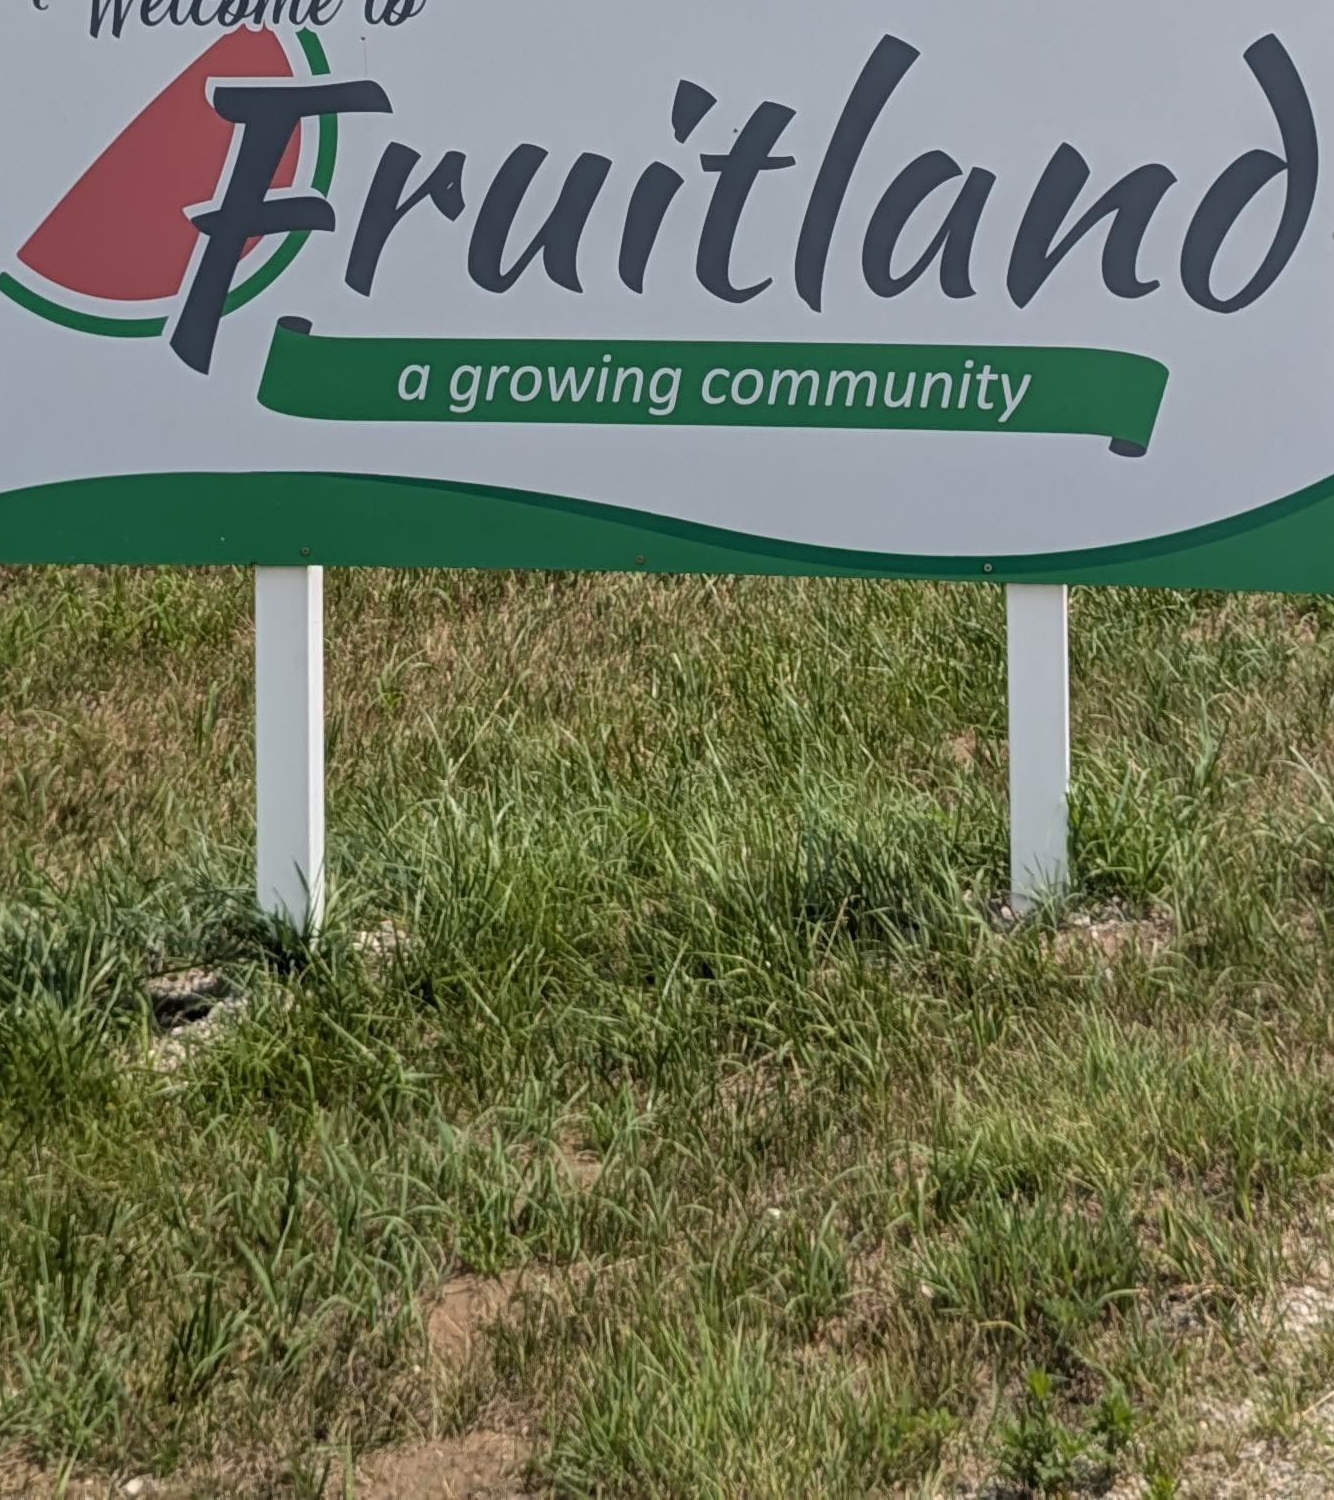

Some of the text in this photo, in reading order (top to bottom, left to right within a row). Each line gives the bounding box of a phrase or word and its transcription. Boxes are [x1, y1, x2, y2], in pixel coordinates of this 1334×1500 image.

[169, 32, 1319, 376] Fruitland
[397, 353, 1033, 424] a growing community
